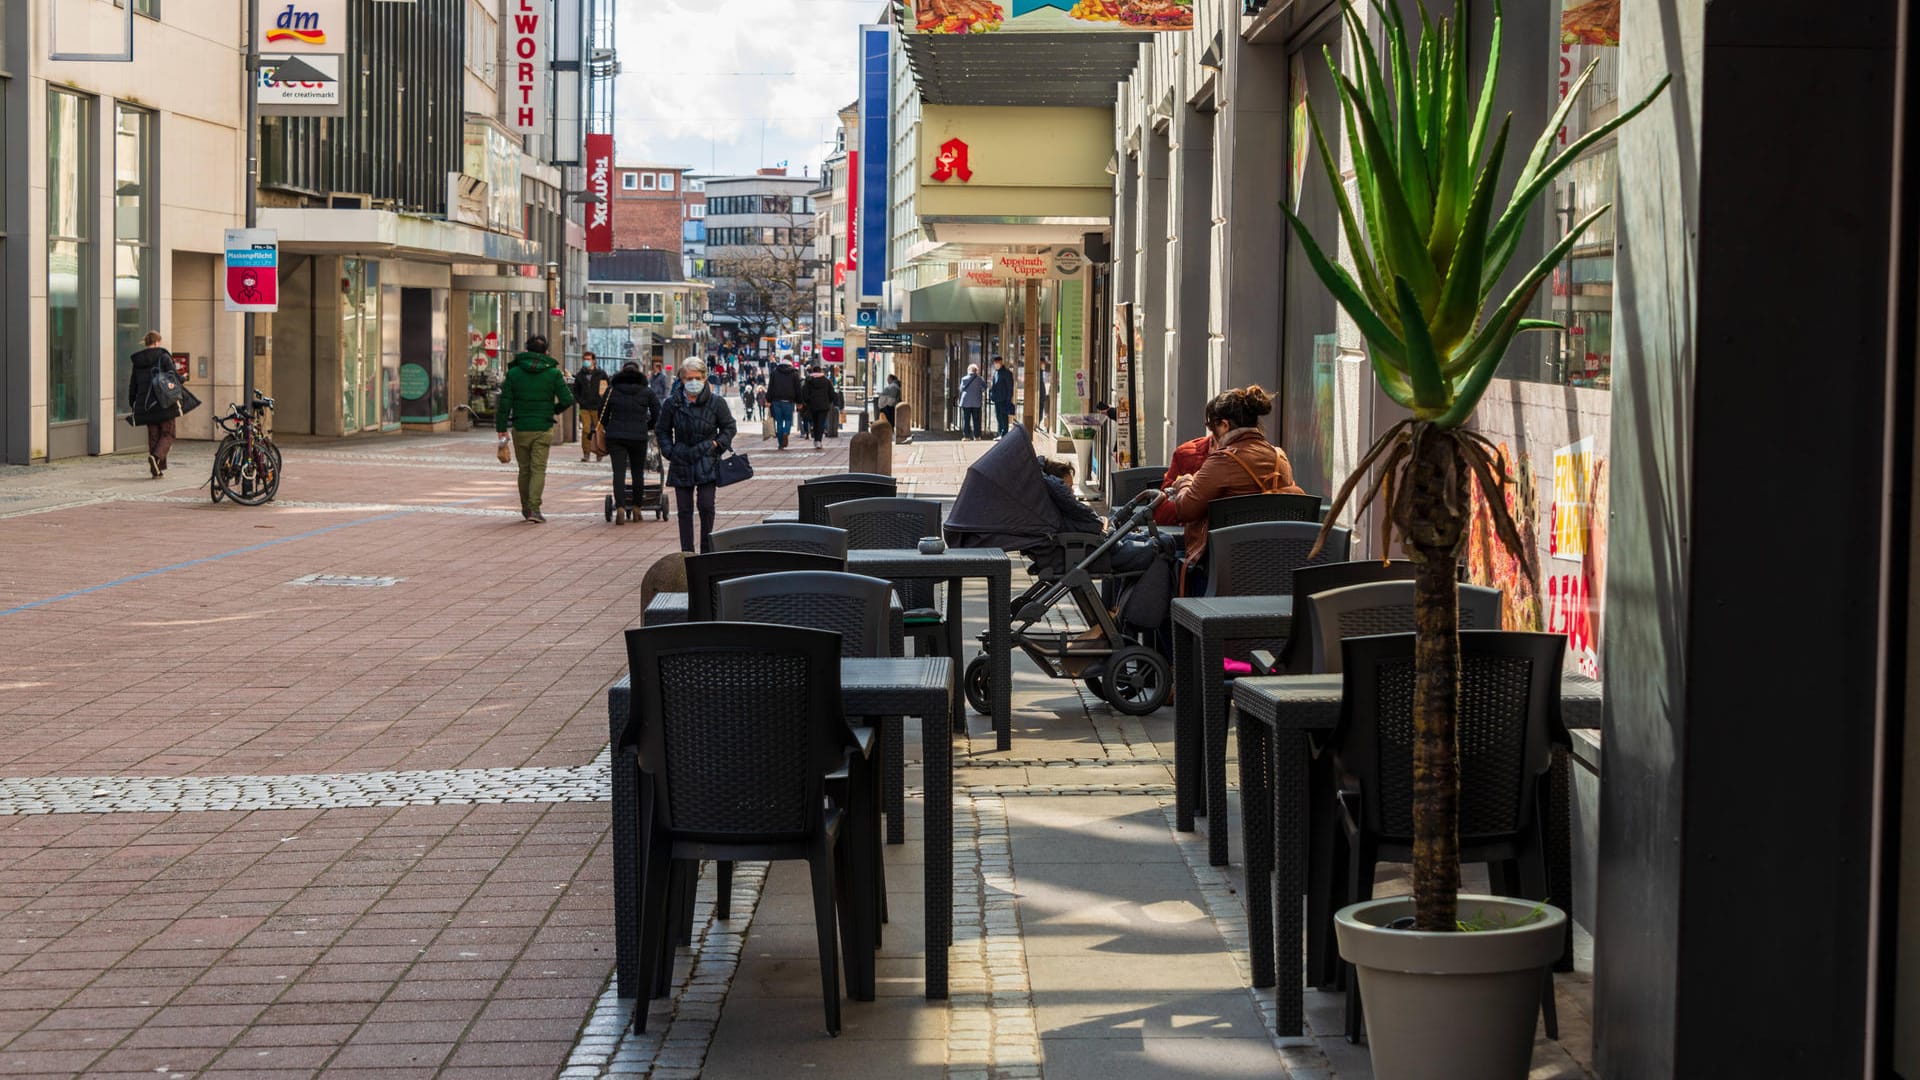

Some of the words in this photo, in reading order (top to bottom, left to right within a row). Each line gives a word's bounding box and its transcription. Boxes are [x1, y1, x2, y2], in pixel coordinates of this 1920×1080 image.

[276, 4, 319, 29] dm
[227, 252, 273, 260] Maskenpflicht
[1555, 450, 1591, 503] FRISCH
[1550, 501, 1557, 556] &
[1557, 505, 1588, 556] WARM
